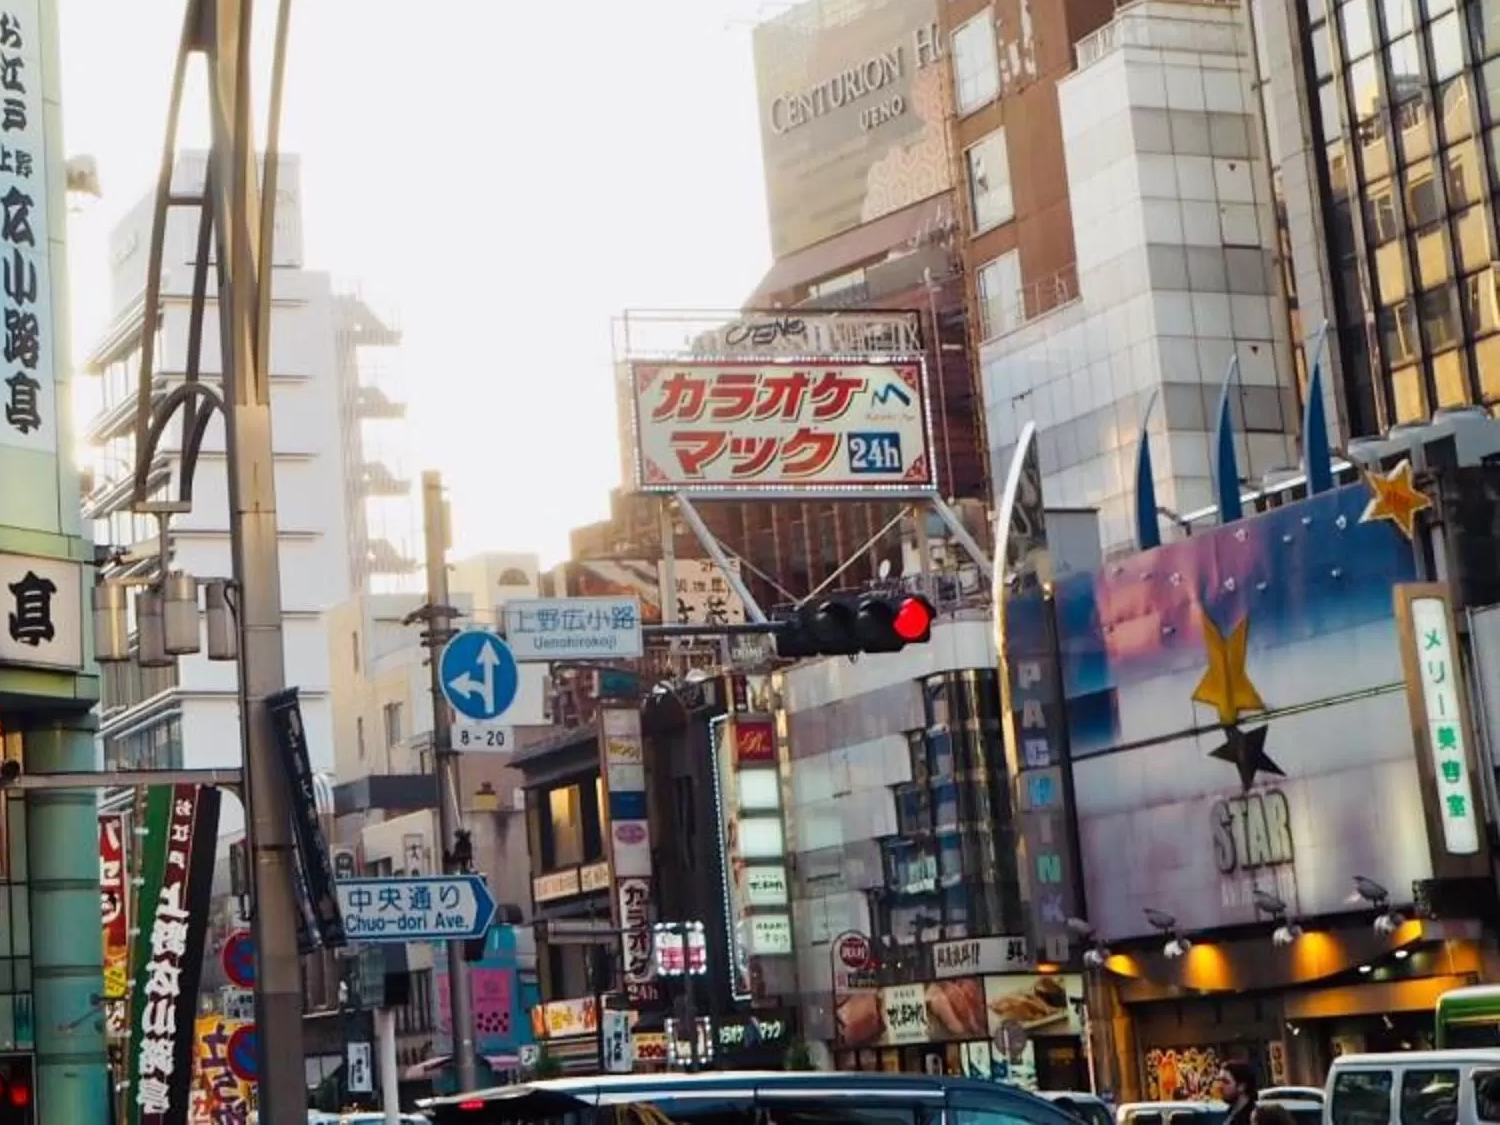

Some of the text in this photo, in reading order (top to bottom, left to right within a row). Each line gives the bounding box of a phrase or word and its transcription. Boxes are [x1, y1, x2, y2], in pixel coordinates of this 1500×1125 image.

[769, 45, 906, 136] CENTURION
[651, 371, 868, 424] カラオケ
[670, 426, 901, 479] マック 24h
[511, 606, 637, 634] 上野広小路
[533, 635, 618, 652] Uenohirokoji
[1423, 627, 1468, 820] メリー美容室
[1211, 787, 1294, 873] STAR
[345, 913, 428, 933] Chuo-dori
[348, 886, 461, 912] 中央通り
[625, 887, 650, 976] カラオケ
